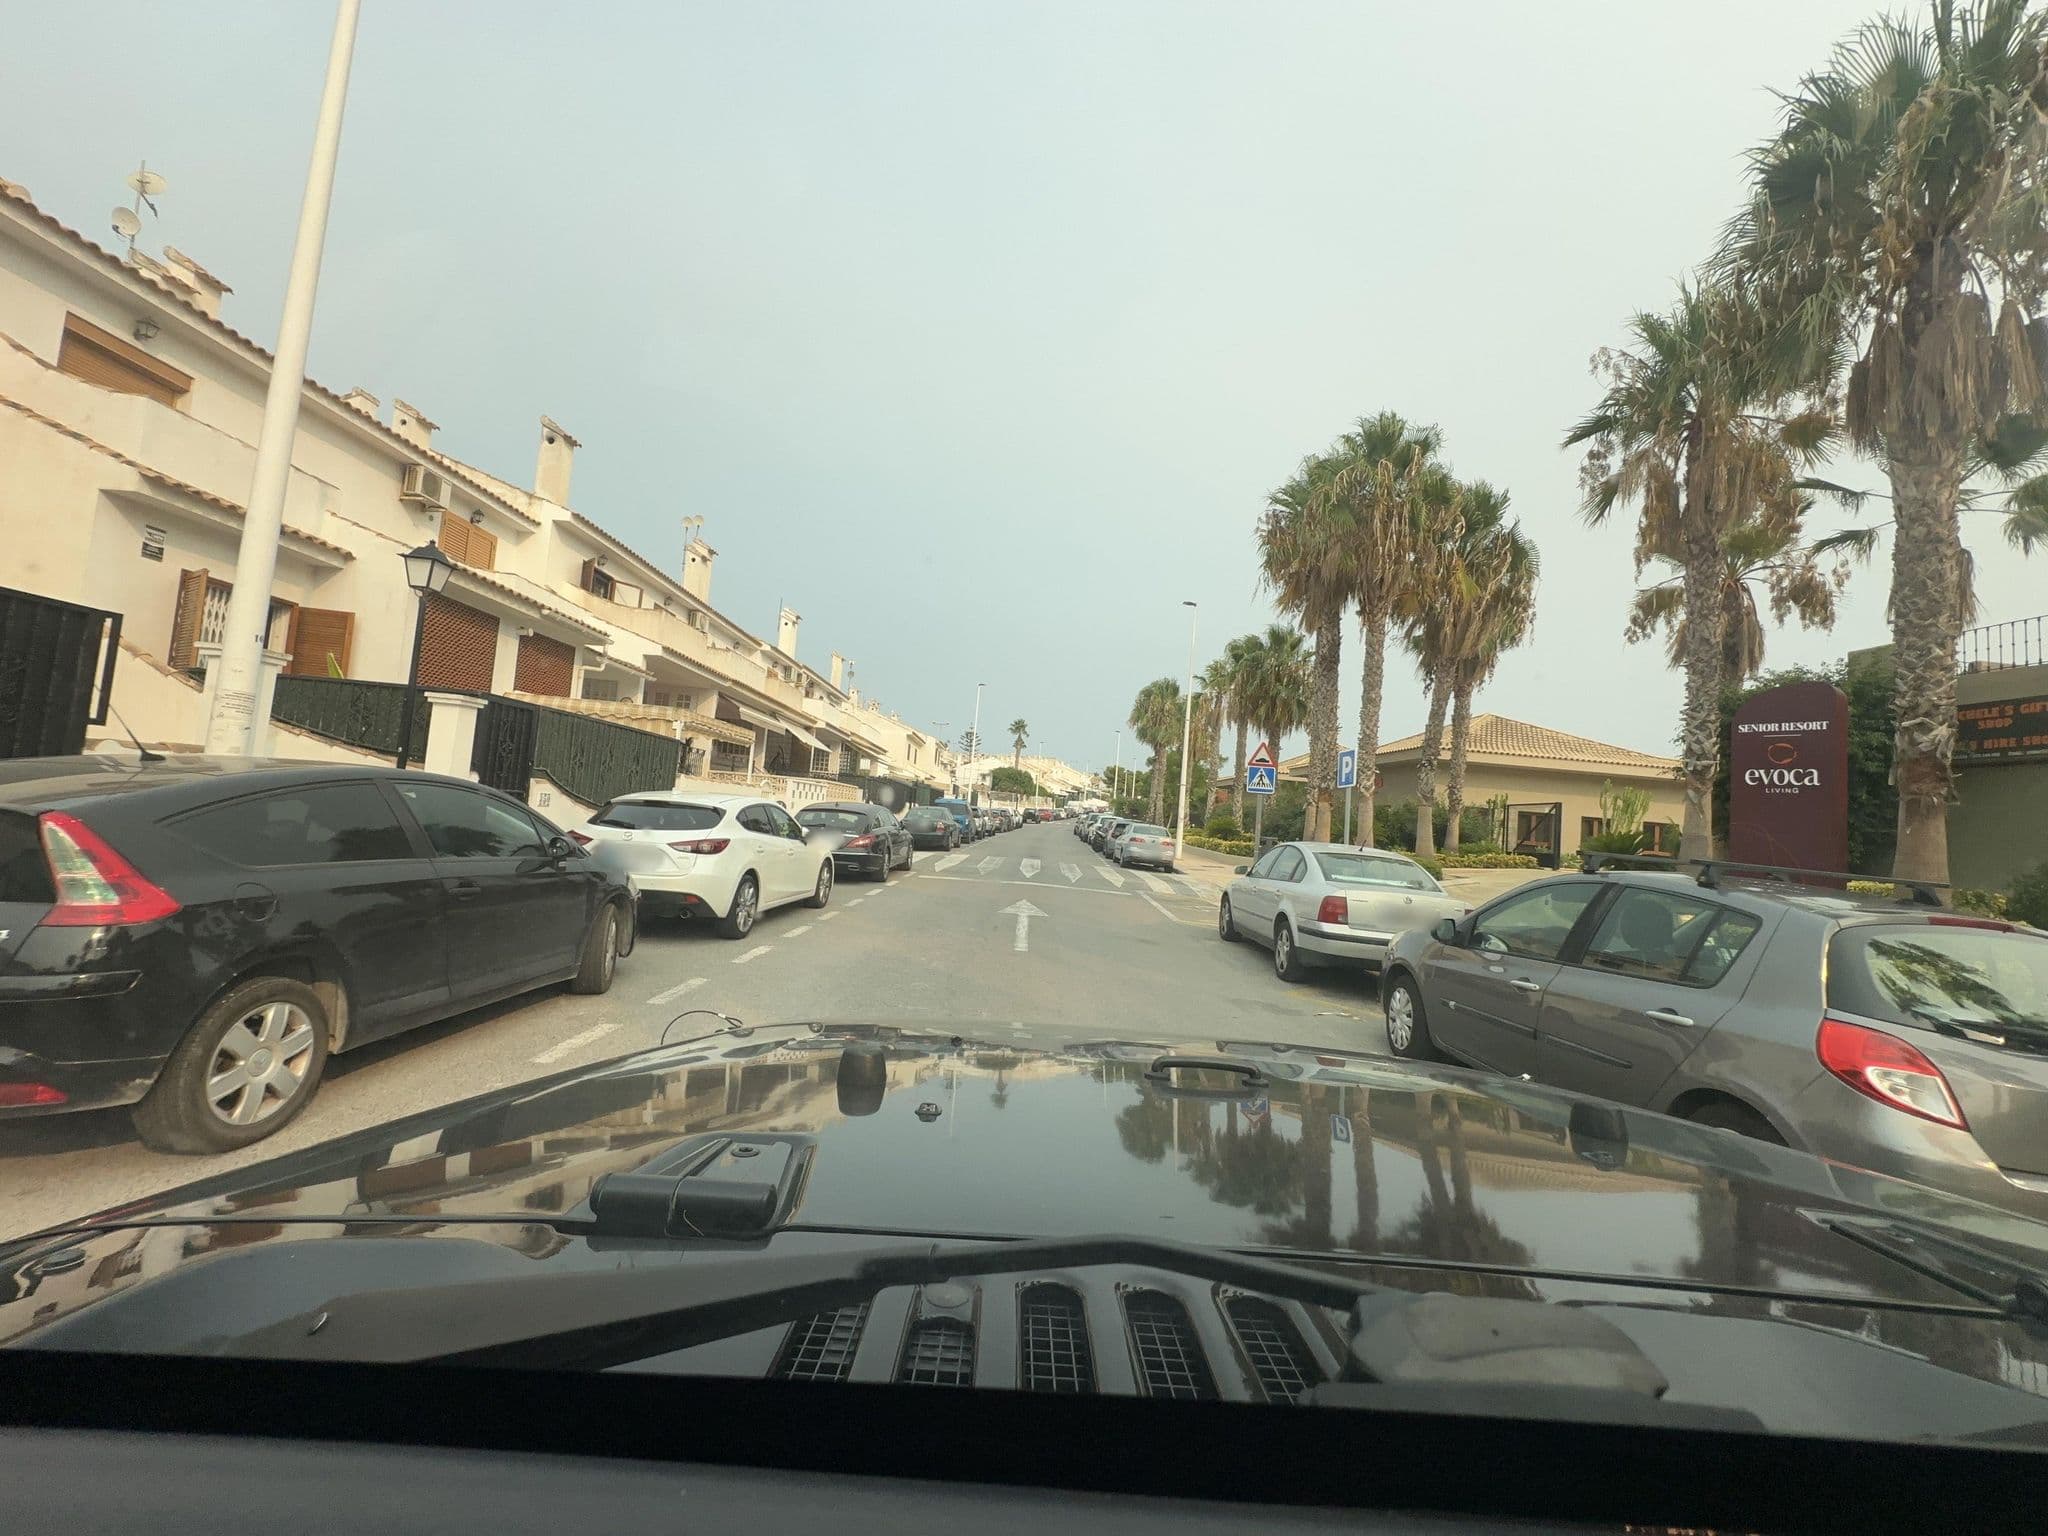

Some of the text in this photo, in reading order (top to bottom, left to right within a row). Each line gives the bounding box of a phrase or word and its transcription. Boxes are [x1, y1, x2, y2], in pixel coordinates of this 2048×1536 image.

[1738, 721, 1830, 733] SENIOR RESORT
[1342, 756, 1352, 782] P
[1744, 768, 1821, 786] evoca
